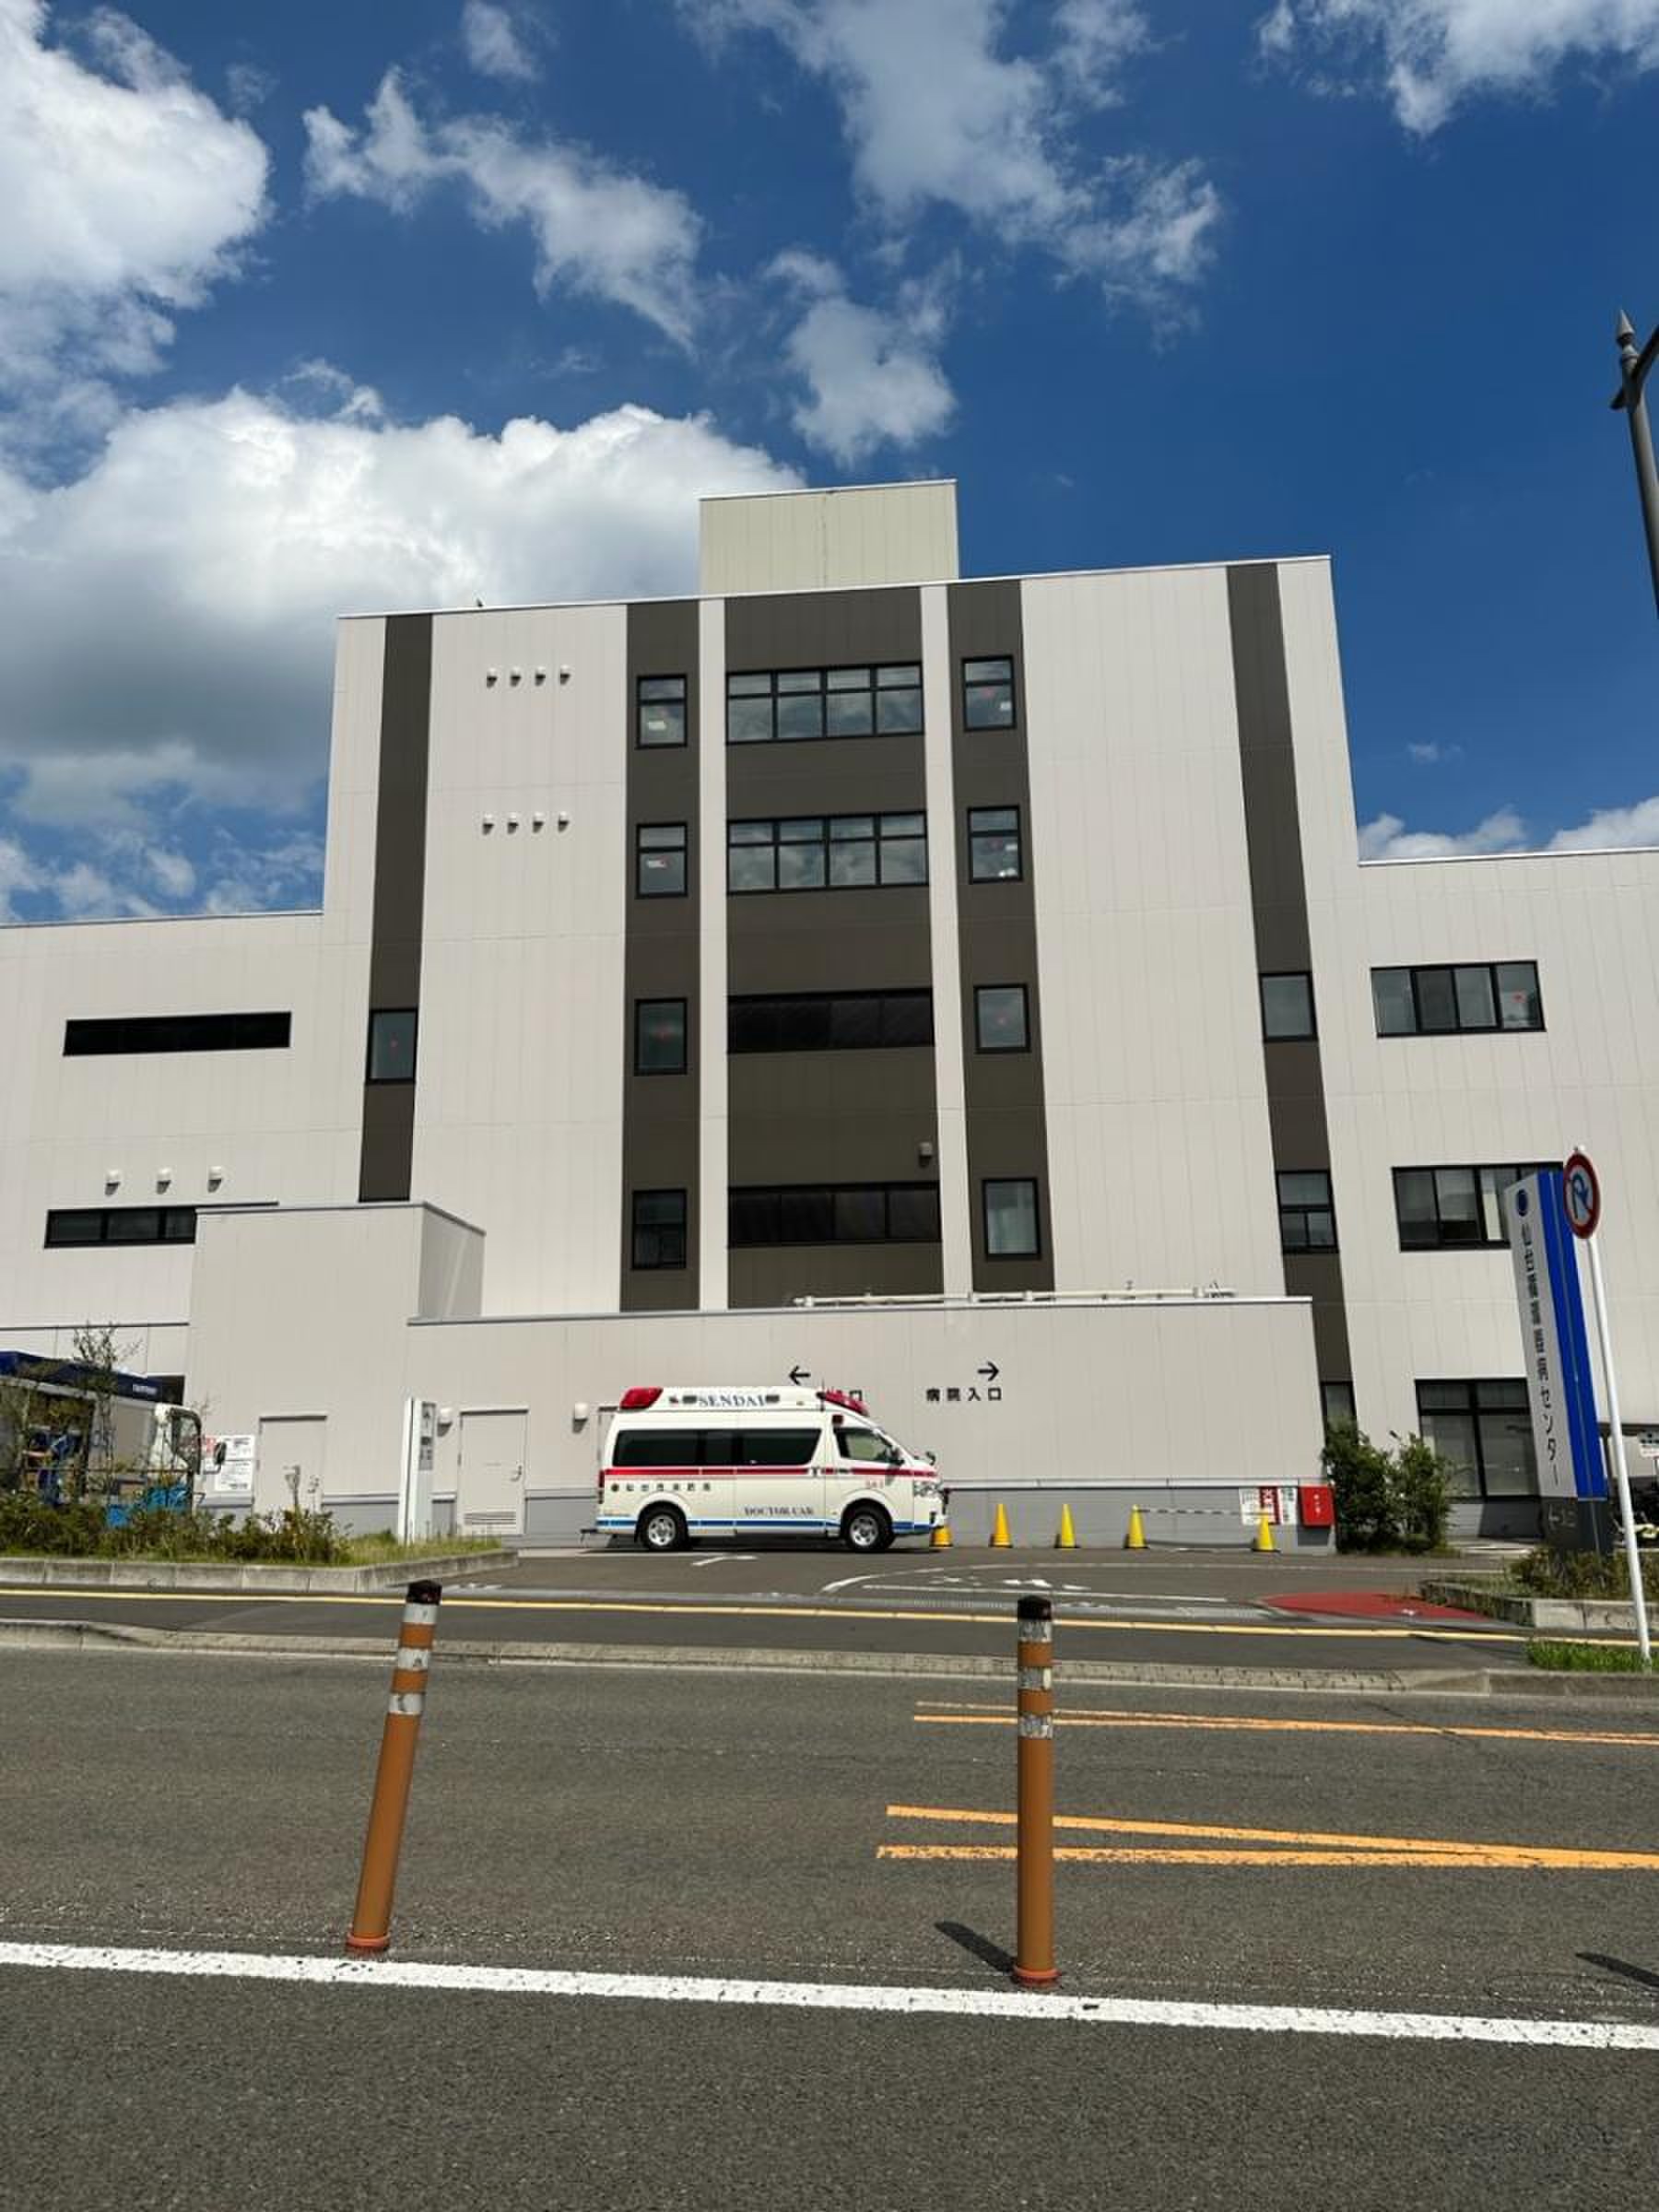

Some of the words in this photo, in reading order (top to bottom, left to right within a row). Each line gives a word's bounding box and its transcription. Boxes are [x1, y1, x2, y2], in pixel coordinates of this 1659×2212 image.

[699, 1394, 766, 1407] SENDAI
[925, 1387, 1002, 1402] 病院入口
